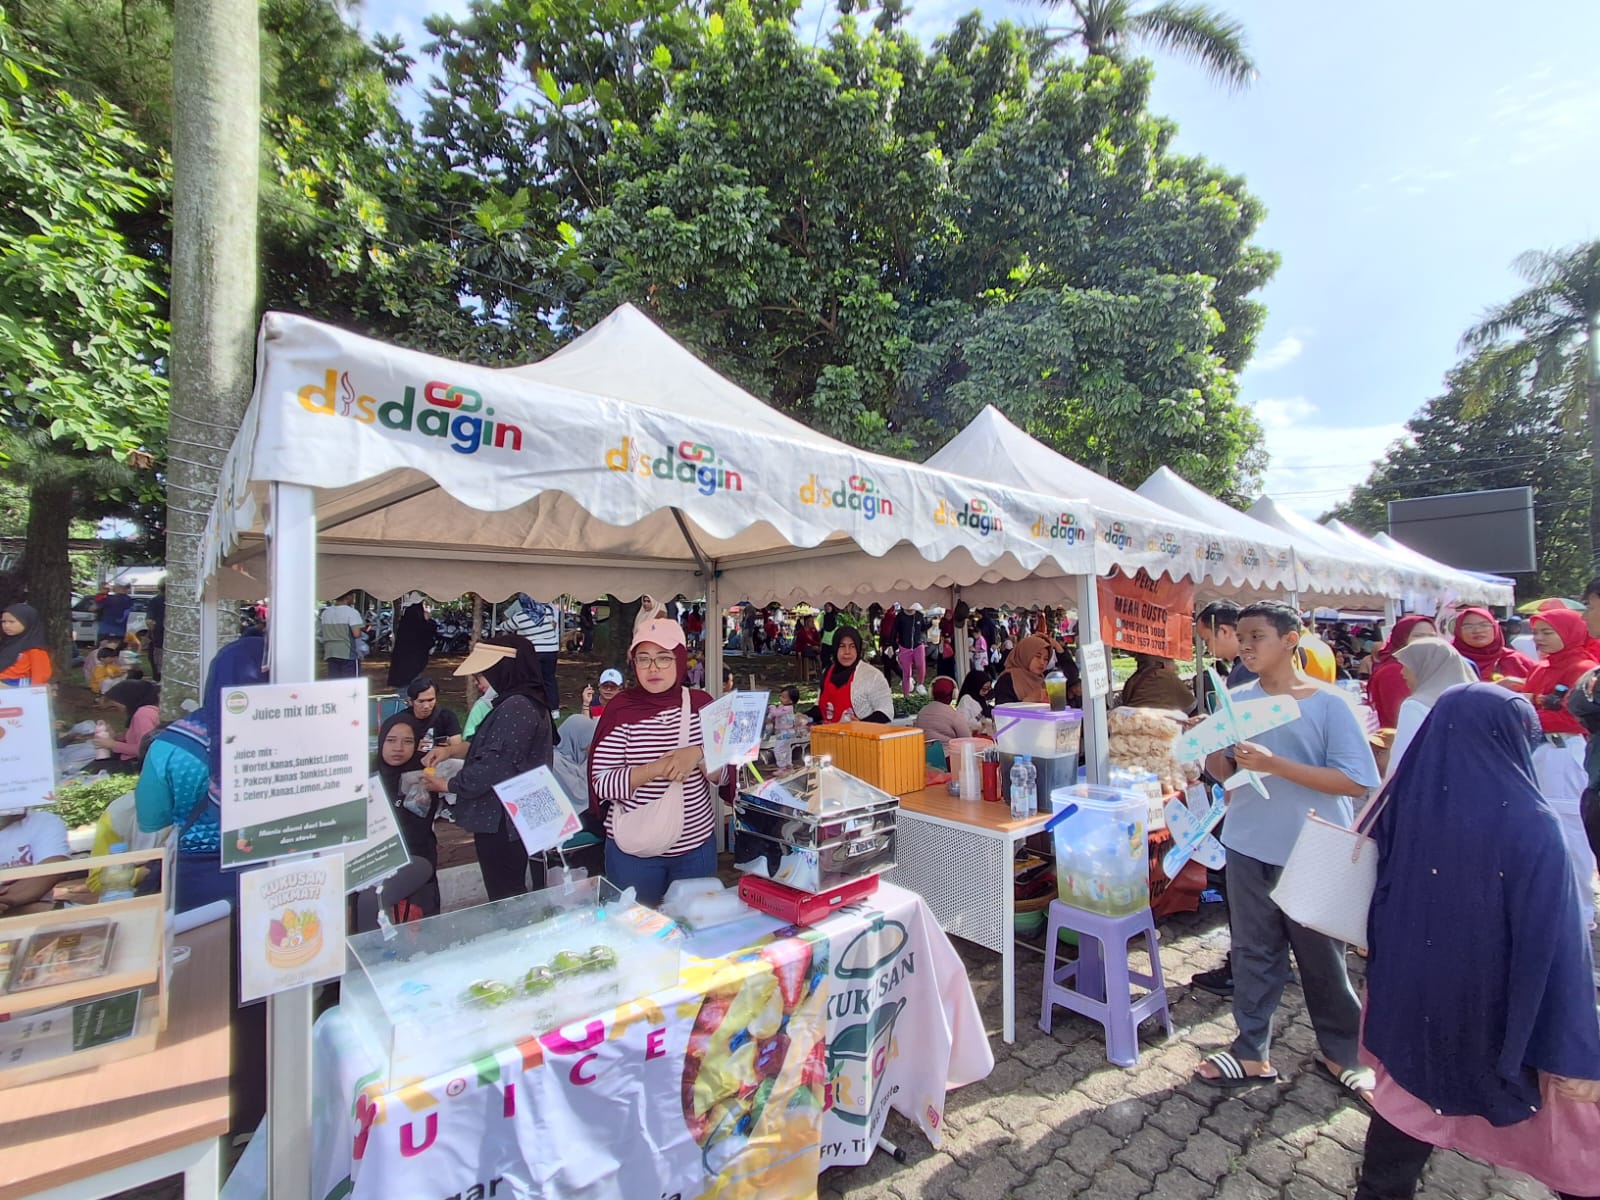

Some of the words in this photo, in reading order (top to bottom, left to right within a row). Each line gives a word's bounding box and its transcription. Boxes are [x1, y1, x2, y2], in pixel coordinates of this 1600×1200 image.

[297, 368, 523, 454] disdagin
[605, 436, 743, 496] disdagin
[799, 474, 893, 520] disdagin
[252, 708, 281, 721] Juice
[284, 705, 302, 718] mix
[234, 748, 256, 760] Juice
[258, 746, 272, 757] mix
[262, 871, 327, 899] KUKUSAN
[827, 952, 915, 1021] KUKSAN
